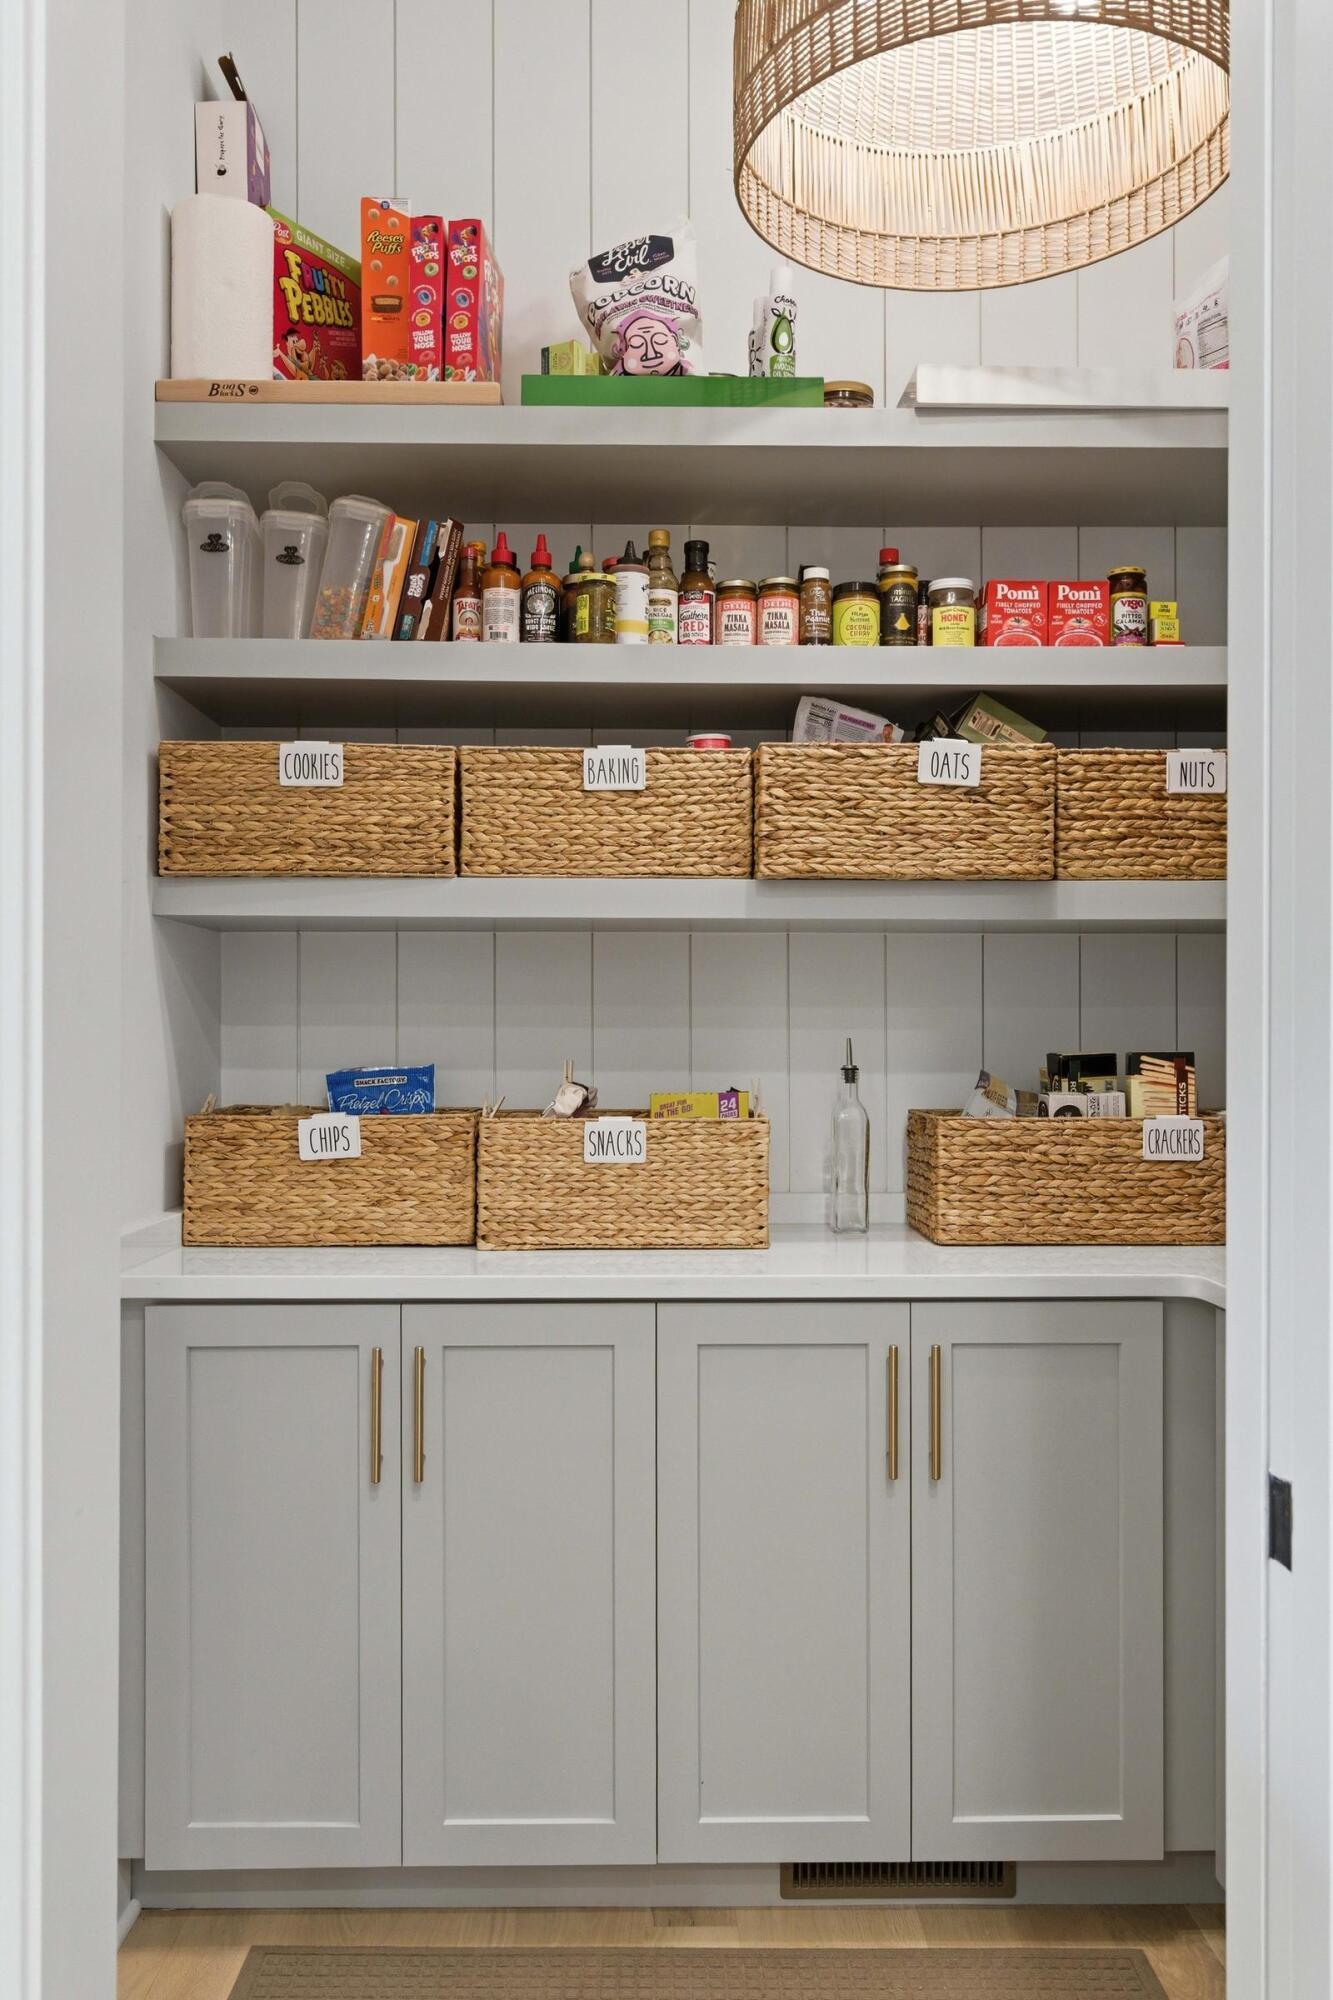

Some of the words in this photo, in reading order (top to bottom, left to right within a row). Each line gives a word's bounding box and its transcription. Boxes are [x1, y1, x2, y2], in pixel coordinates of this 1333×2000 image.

[296, 231, 325, 255] GIANT
[326, 248, 346, 266] SIZE
[371, 242, 402, 255] Puffs
[614, 245, 651, 272] Evil
[279, 276, 353, 328] PEBBLES
[588, 275, 696, 328] POPCORN
[683, 621, 704, 632] RED
[724, 623, 750, 632] MASALA
[727, 614, 747, 623] TIKKA
[764, 621, 790, 630] MASALA
[767, 612, 787, 621] TIKKA
[805, 615, 831, 624] Peanut
[941, 613, 967, 623] HONEY
[284, 753, 340, 781] COOKIES
[588, 757, 640, 785] BAKING
[931, 751, 970, 780] OATS
[1179, 761, 1215, 788] NUTS
[337, 1091, 386, 1115] Pretzel
[654, 1111, 664, 1120] ON
[667, 1107, 679, 1118] THE
[720, 1097, 737, 1112] 24
[309, 1125, 351, 1154] CHIPS
[588, 1130, 642, 1157] SNACKS
[1148, 1128, 1201, 1155] CRACKERS
